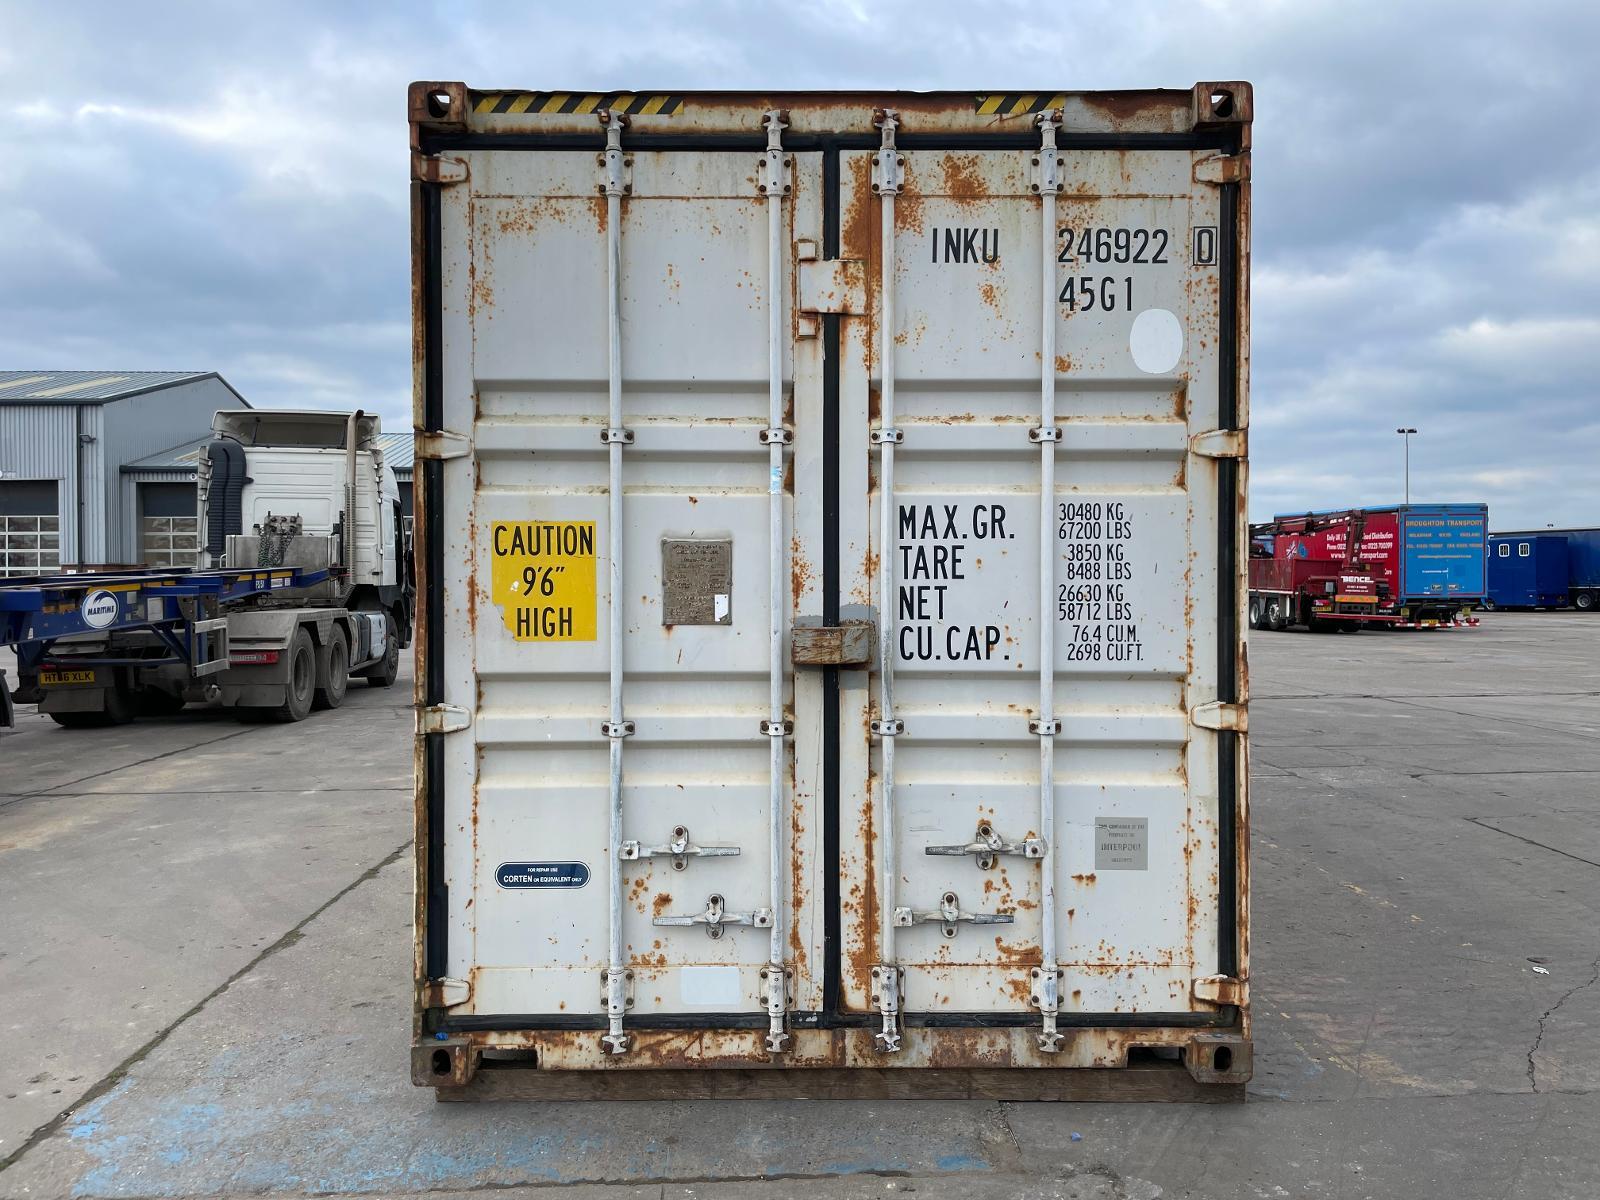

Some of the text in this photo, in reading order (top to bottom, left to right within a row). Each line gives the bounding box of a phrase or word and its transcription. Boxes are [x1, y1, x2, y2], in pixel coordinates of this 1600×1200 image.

[932, 228, 998, 264] INKU
[1058, 228, 1169, 264] 246922
[1059, 276, 1133, 312] 45G1
[899, 503, 1124, 540] MAX.GR. 30480 KG
[1059, 522, 1132, 540] 67200 LBS
[494, 524, 593, 557] CAUTION
[899, 544, 1124, 580] TARE 3850 KG
[1067, 562, 1132, 580] 8488 LBS
[87, 605, 114, 616] MARITIME
[899, 584, 1124, 620] NET 26630 KG
[1059, 603, 1132, 621] 58712 LBS
[516, 606, 573, 638] HIGH
[899, 625, 1140, 661] CU.CAP. 76.4 CU.M.
[1067, 643, 1144, 661] 2698 CU.FT.
[72, 672, 91, 681] XLK
[503, 875, 533, 883] CORTEN
